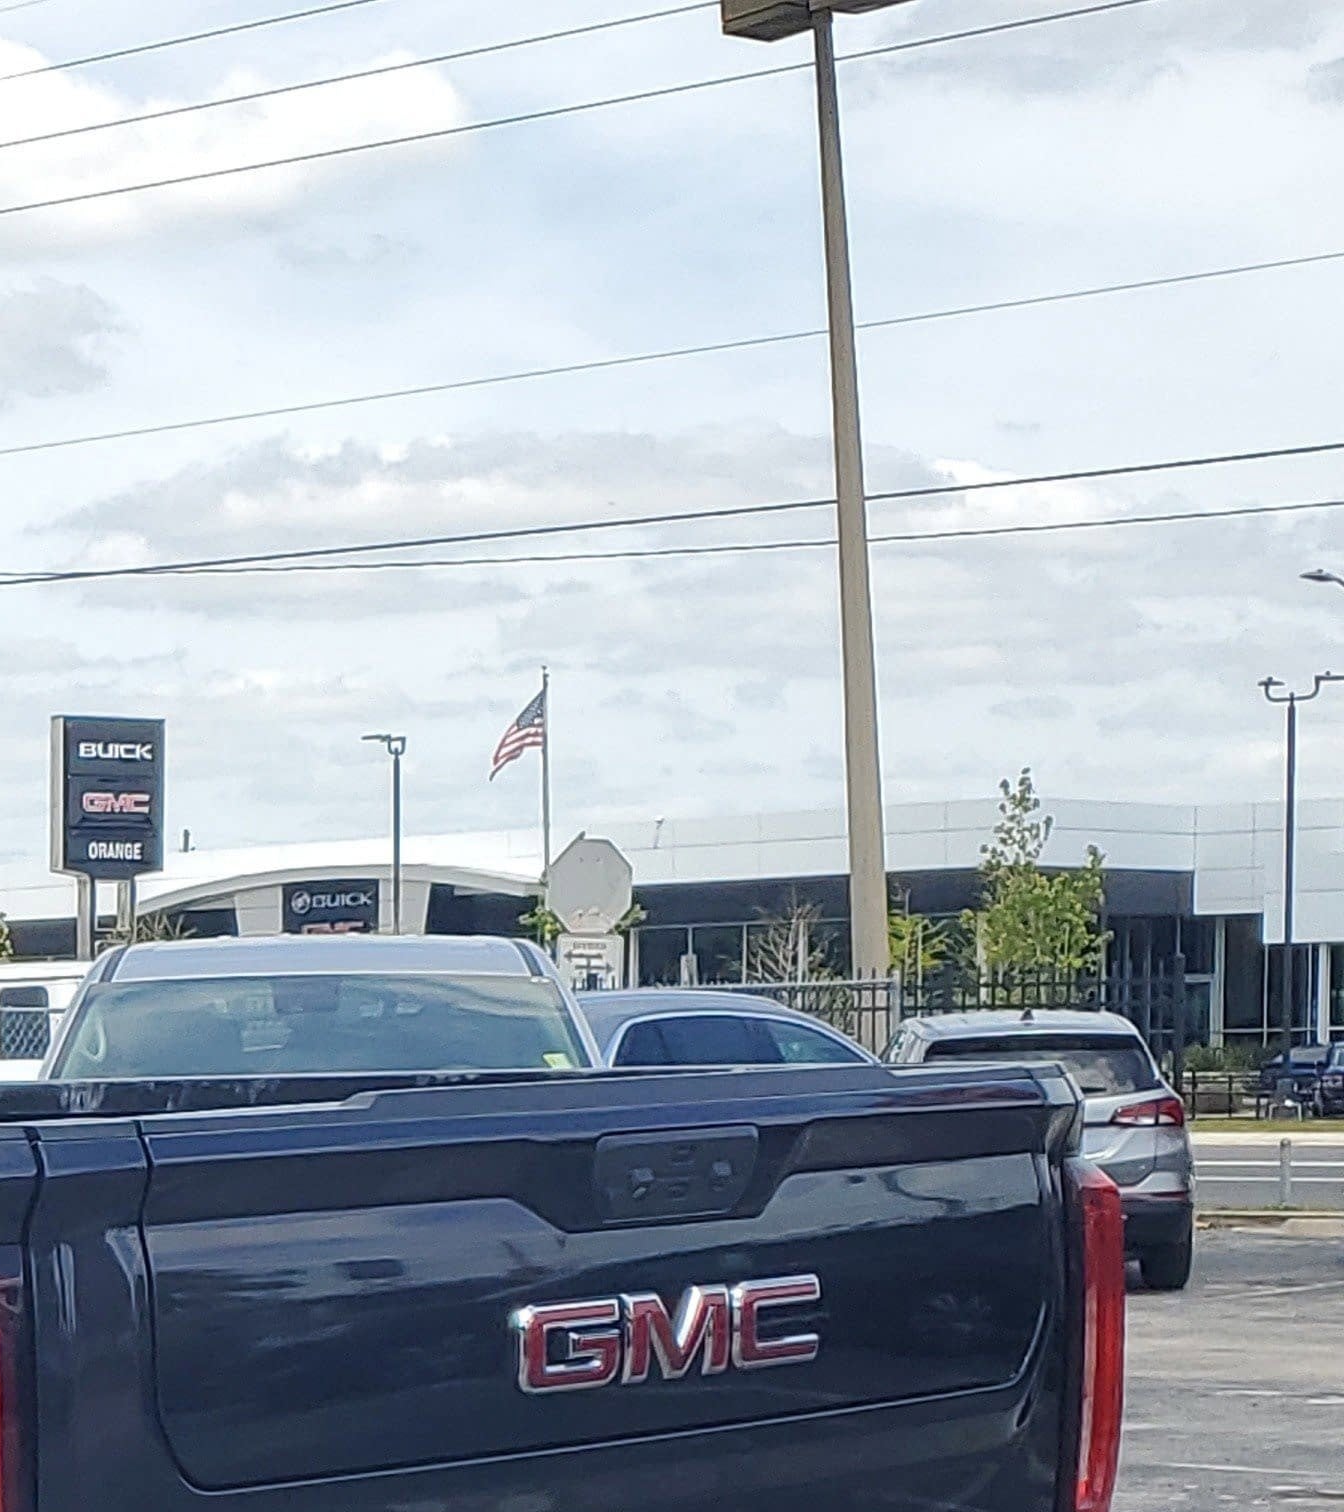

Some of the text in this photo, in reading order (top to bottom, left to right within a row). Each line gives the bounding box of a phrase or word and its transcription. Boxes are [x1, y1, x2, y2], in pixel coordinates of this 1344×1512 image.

[78, 742, 153, 760] BUICK
[82, 792, 151, 814] GMC
[88, 841, 143, 860] ORANGE
[312, 891, 373, 908] BUICK
[517, 1274, 821, 1393] GMC
